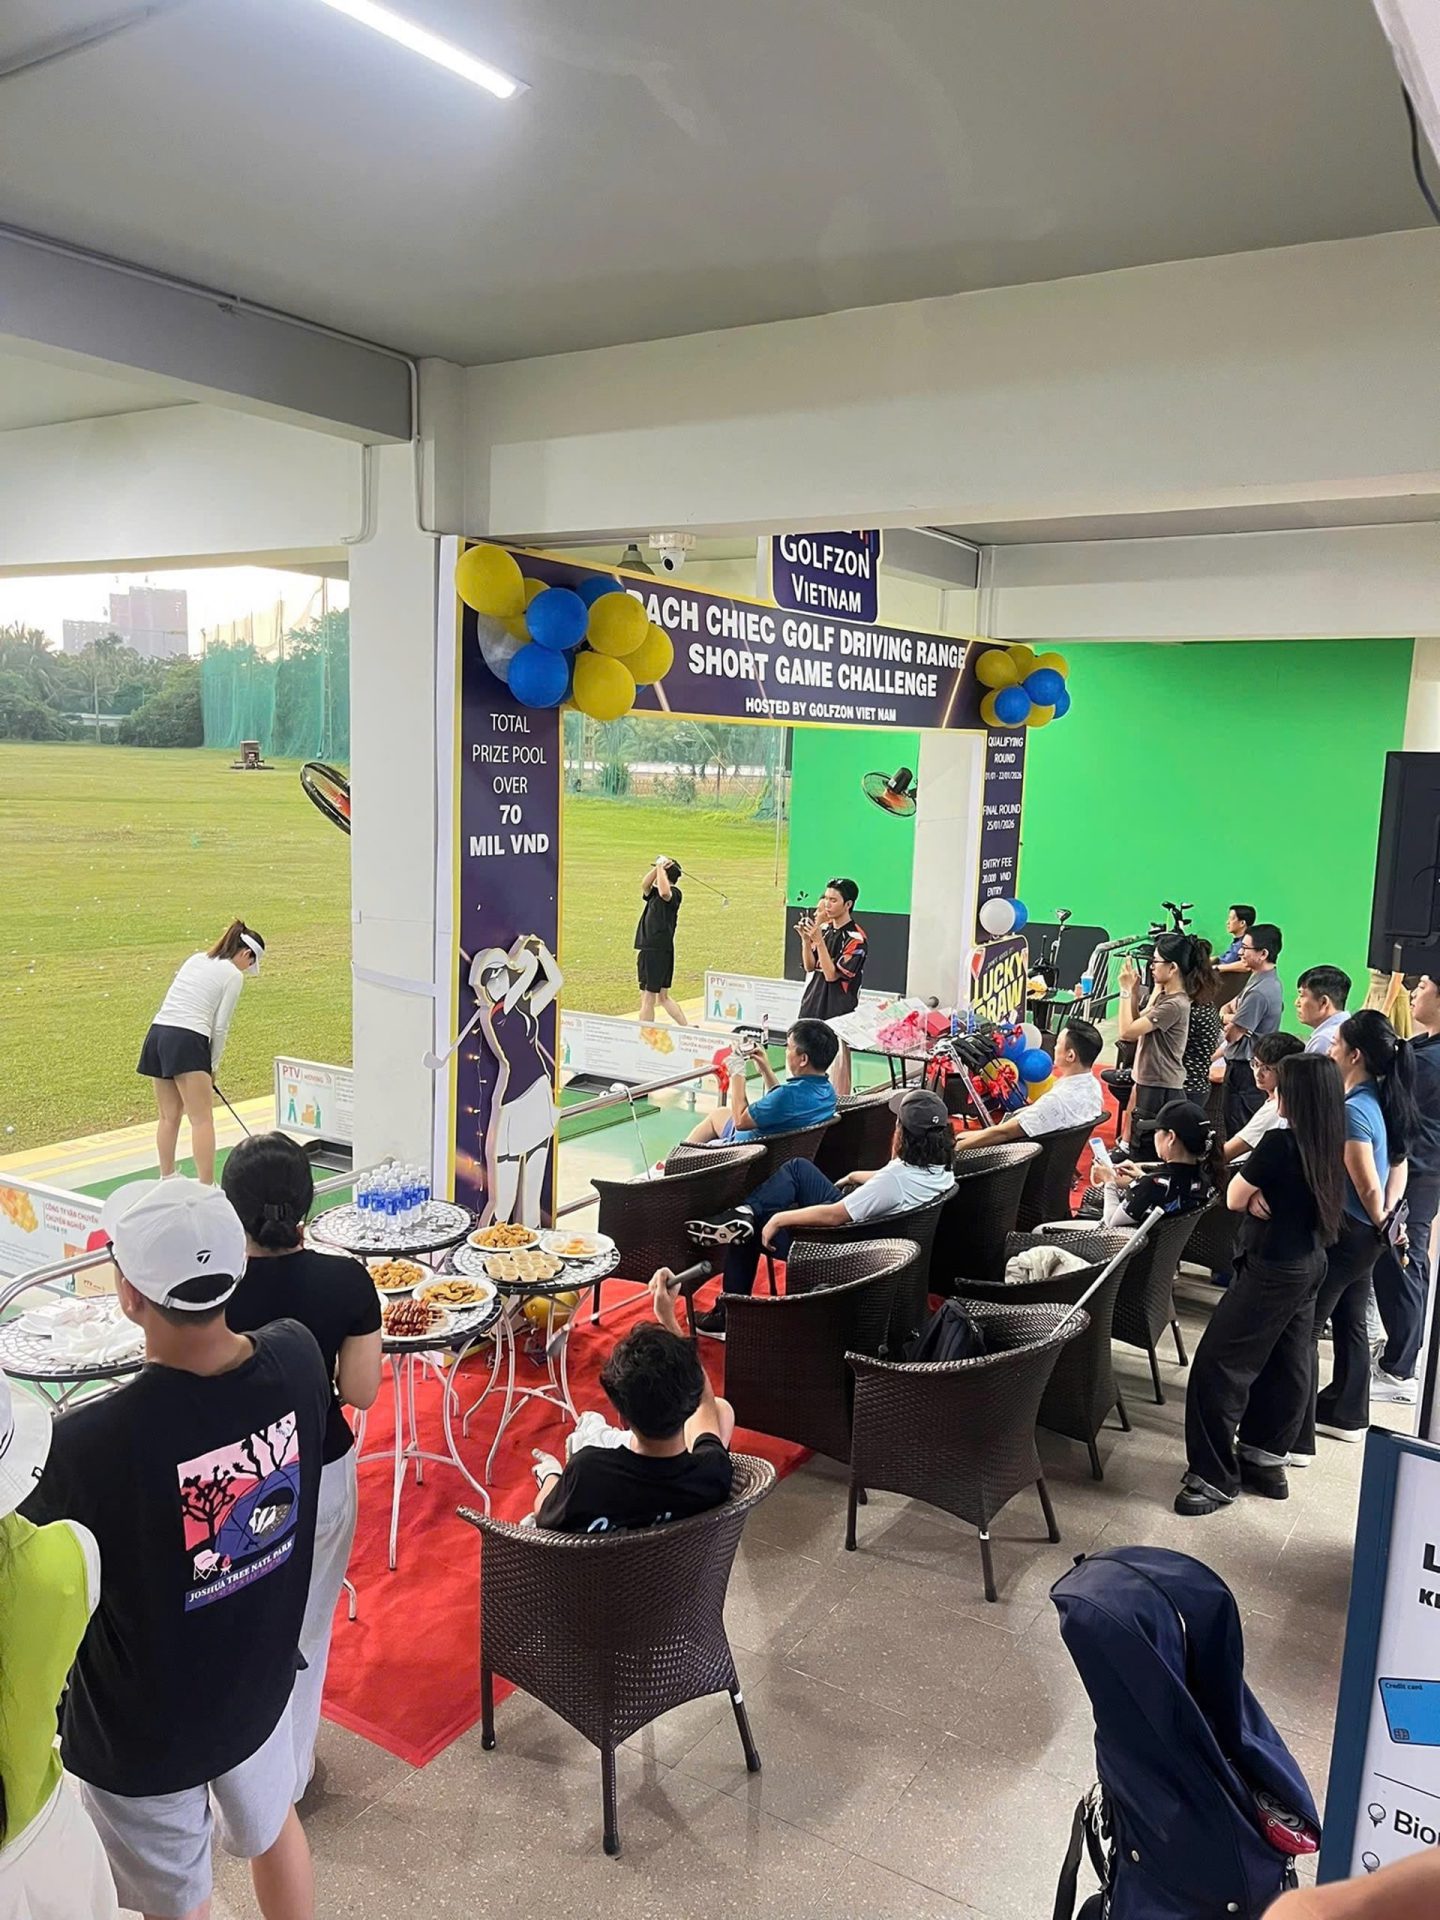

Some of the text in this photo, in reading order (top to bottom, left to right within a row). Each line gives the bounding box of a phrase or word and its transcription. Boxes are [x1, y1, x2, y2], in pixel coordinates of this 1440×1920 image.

[780, 534, 870, 579] GOLFZON
[791, 573, 861, 613] VIETNAM
[626, 589, 966, 669] ACH CHIEC GOLF DRIVING RANGE
[688, 643, 937, 697] SHORT GAME CHALLENGE
[745, 697, 897, 722] HOSTED BY GOLFZON VIET NAM
[490, 713, 531, 733] TOTAL
[988, 736, 1024, 748] QUALIFYING
[472, 744, 547, 764] PRIZE POOL
[994, 752, 1016, 764] ROUND
[493, 776, 528, 794] OVER
[499, 804, 522, 825] 70
[983, 803, 1021, 816] FINAL ROUND
[469, 833, 549, 857] MIL VND
[982, 856, 1013, 870] ENTRY FEE
[1000, 871, 1012, 881] VND
[987, 885, 1003, 897] ENTRY
[710, 976, 726, 986] PTV
[973, 951, 1024, 1009] LUCKY
[282, 1065, 300, 1079] PTV
[189, 1579, 226, 1603] JOSHUA
[226, 1568, 251, 1585] TREE
[272, 1538, 294, 1560] PARK
[1394, 1809, 1440, 1846] Bio
